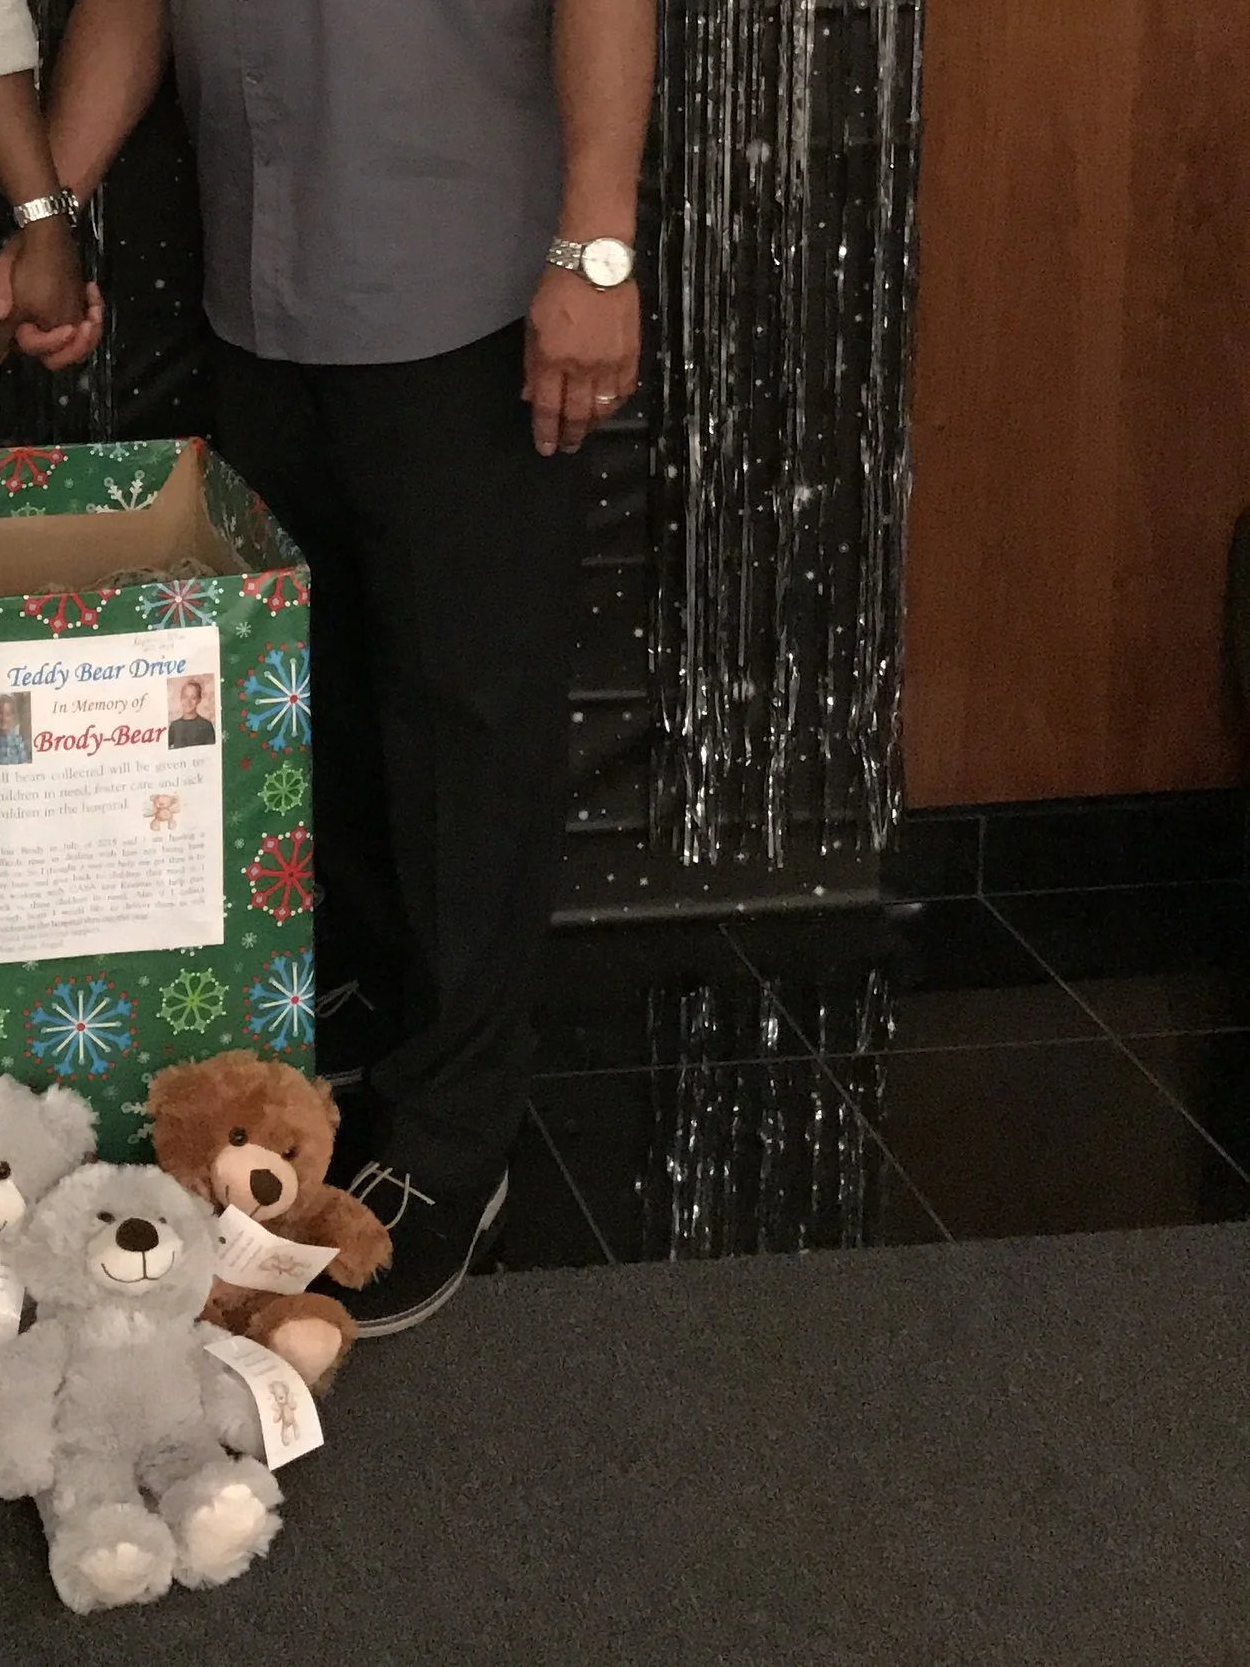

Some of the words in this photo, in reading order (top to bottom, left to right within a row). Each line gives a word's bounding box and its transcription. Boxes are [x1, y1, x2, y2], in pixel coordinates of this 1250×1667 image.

[7, 661, 69, 690] Teddy
[75, 660, 125, 683] Bear
[129, 655, 187, 678] Drive
[52, 701, 68, 714] In
[72, 698, 128, 716] Memory
[131, 693, 149, 710] of
[34, 725, 167, 756] Brody-Bear
[51, 765, 104, 781] collected
[110, 762, 130, 774] will
[136, 761, 150, 772] be
[155, 760, 187, 773] given
[44, 790, 56, 799] in
[130, 781, 153, 791] care
[158, 776, 179, 789] and
[44, 806, 55, 818] in
[59, 803, 79, 815] the
